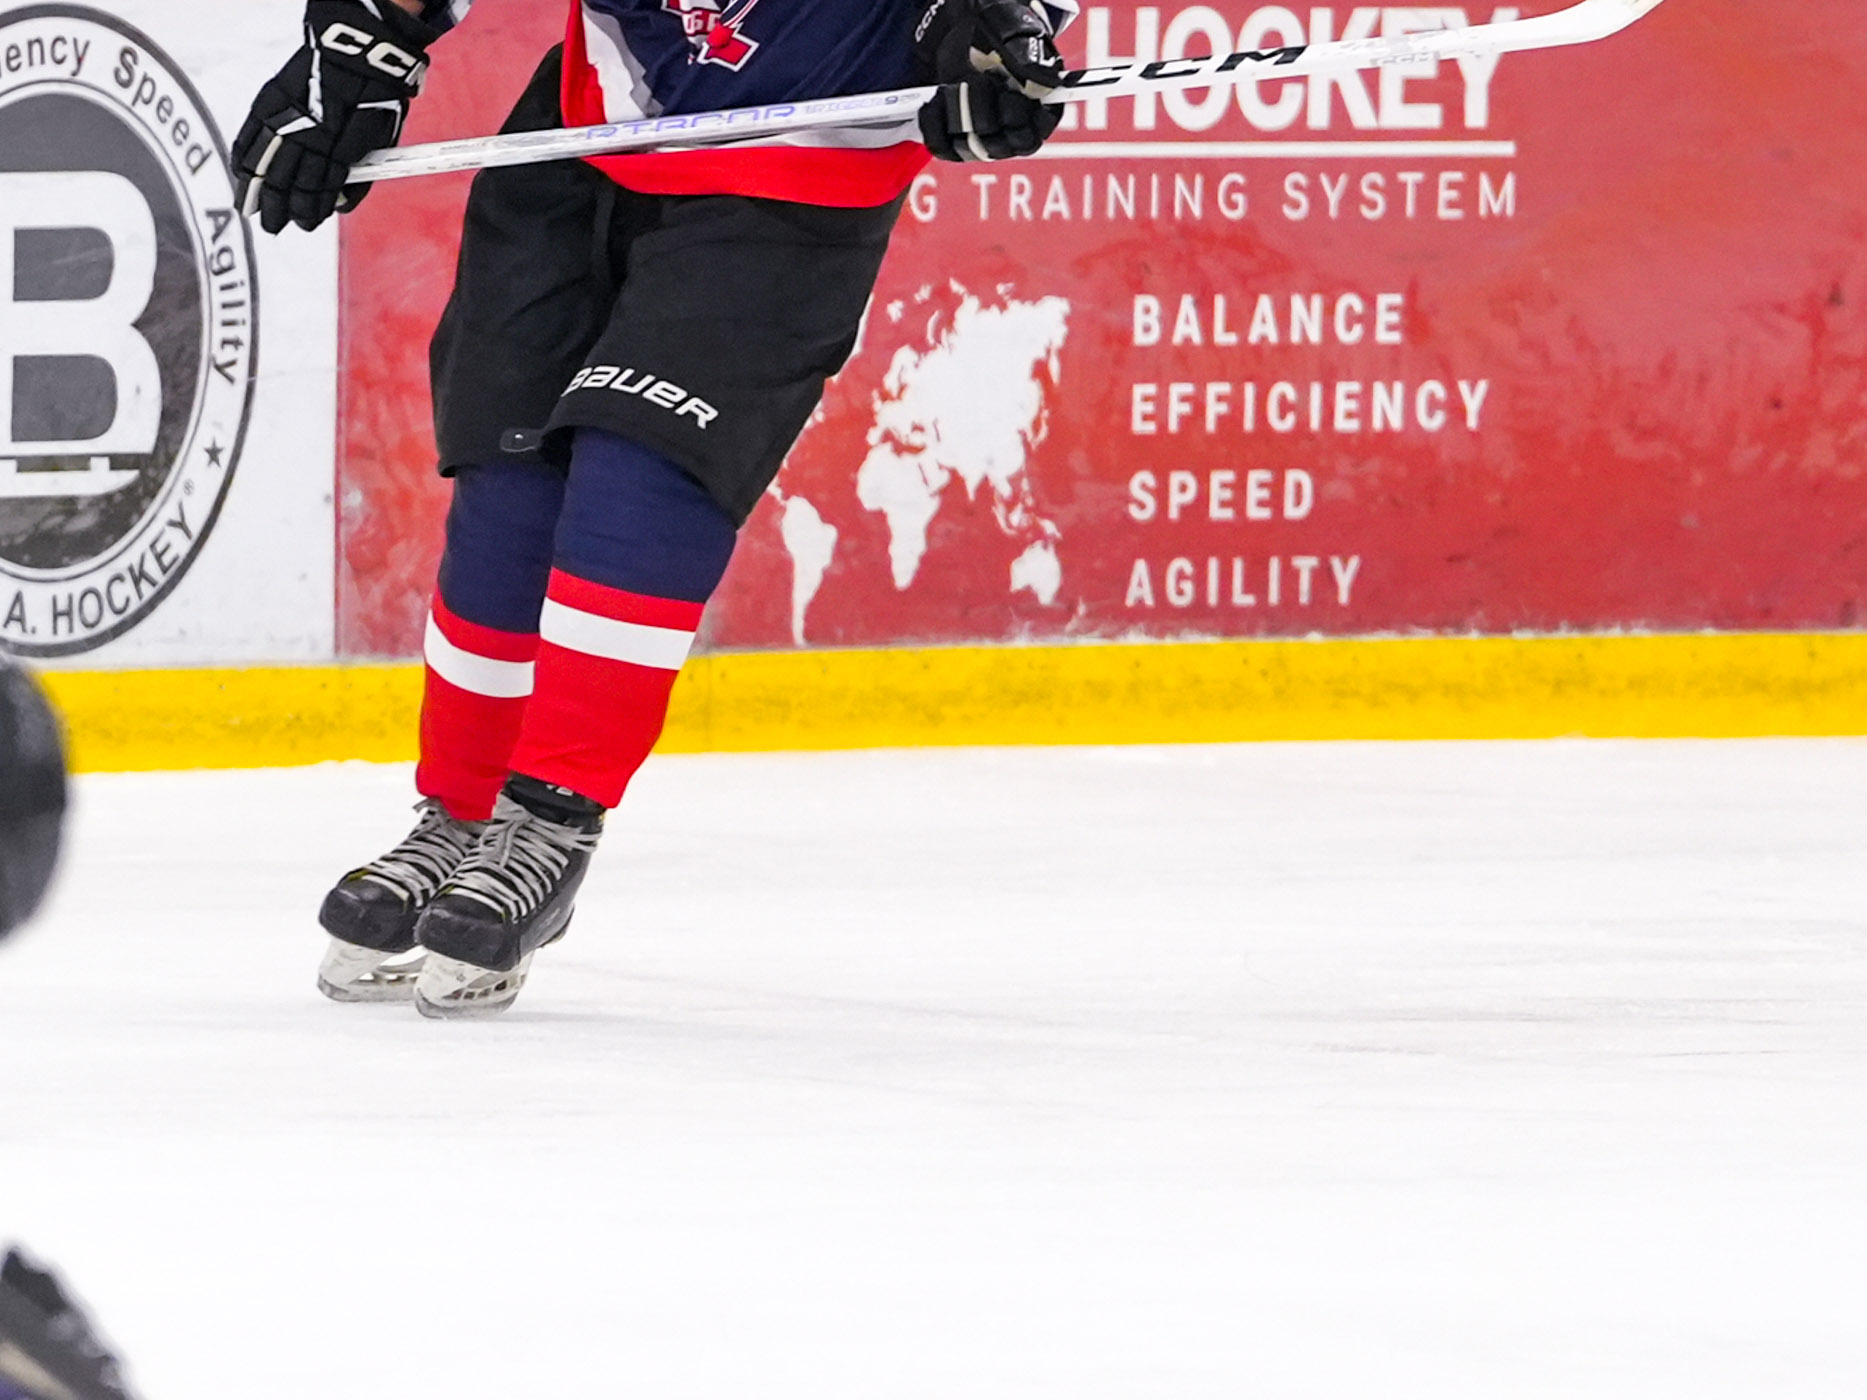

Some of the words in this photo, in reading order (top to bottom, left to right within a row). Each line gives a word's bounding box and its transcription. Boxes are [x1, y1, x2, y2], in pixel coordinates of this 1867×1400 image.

[113, 46, 212, 175] Speed
[204, 209, 246, 385] Agility
[971, 172, 1247, 221] TRAINING
[1282, 171, 1515, 221] SYSTEM
[1133, 293, 1404, 346] BALANCE
[1131, 379, 1489, 435] EFFICIENCY
[1128, 469, 1314, 522] SPEED
[52, 500, 193, 636] HOCKEY
[1125, 555, 1361, 608] AGILITY
